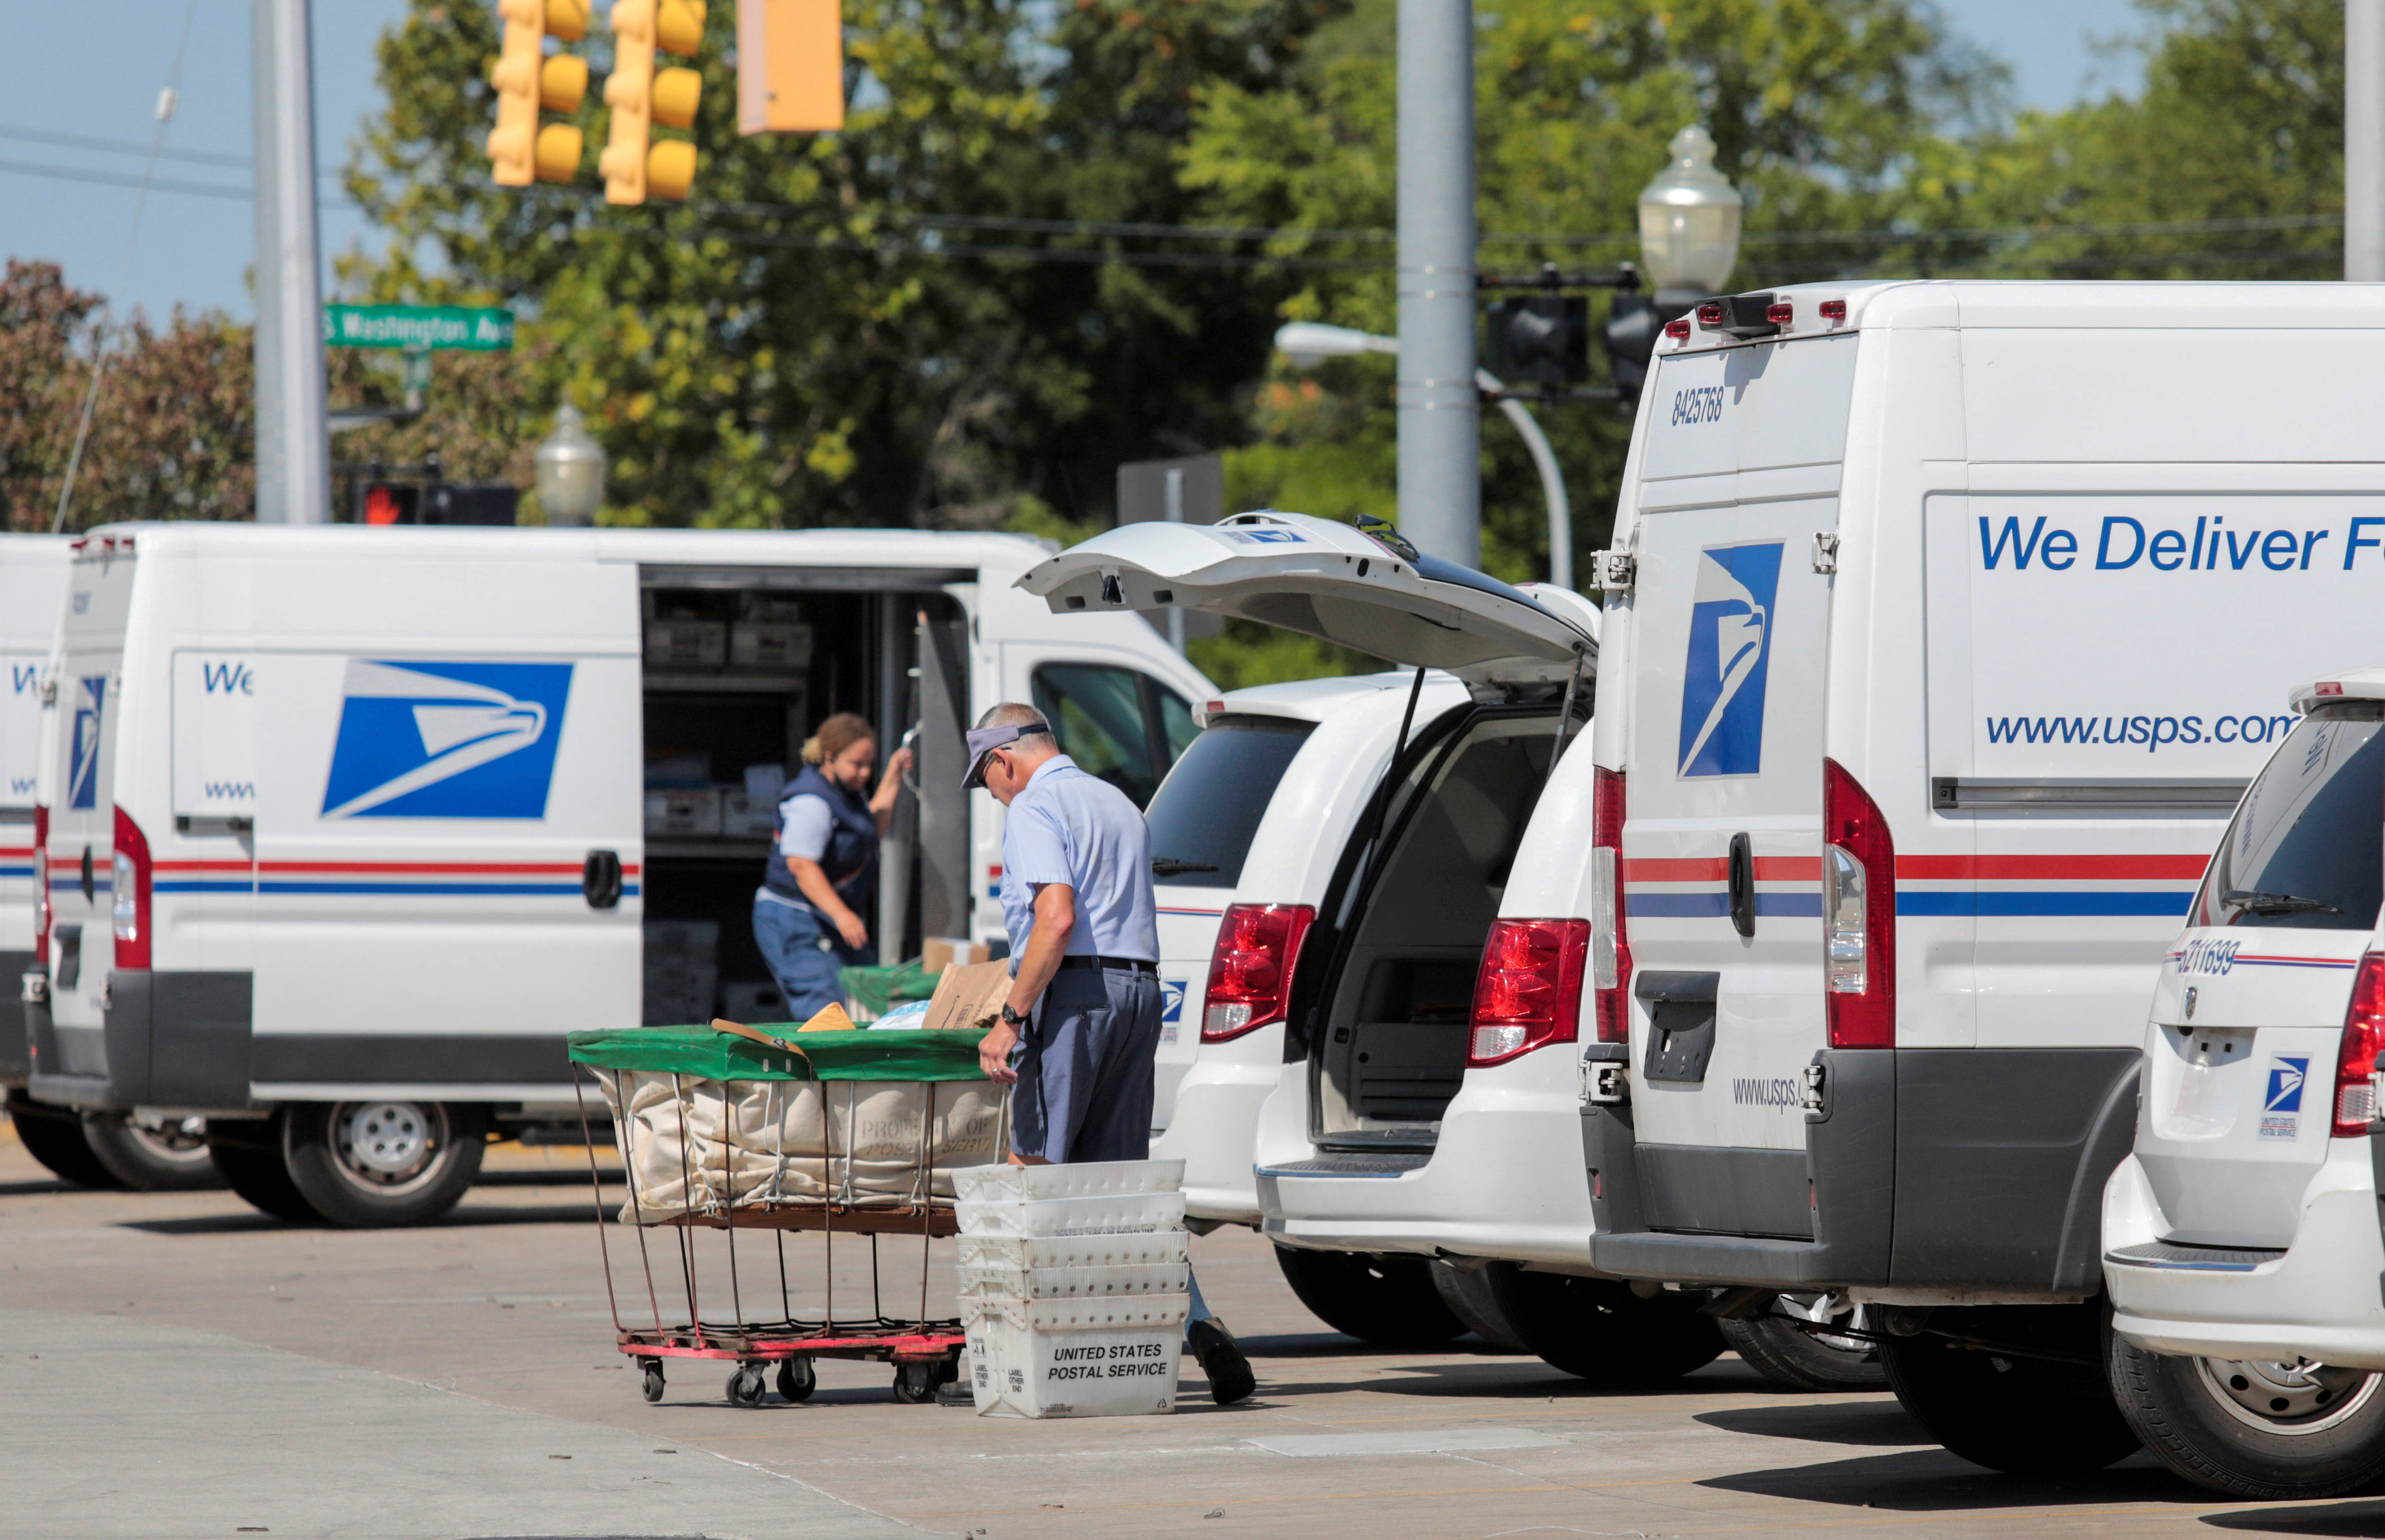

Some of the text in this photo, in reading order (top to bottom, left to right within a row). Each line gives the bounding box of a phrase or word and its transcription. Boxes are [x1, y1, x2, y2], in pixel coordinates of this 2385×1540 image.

[342, 312, 469, 349] Washington
[1672, 386, 1724, 427] 8425768
[1978, 516, 2385, 570] We Deliver F
[2178, 939, 2241, 976] 5211699
[1733, 1078, 1801, 1115] www.usps.
[1048, 1362, 1167, 1380] POSTAL SERVICE
[1054, 1344, 1162, 1361] UNITED STATES
[1008, 1368, 1023, 1377] LABEL
